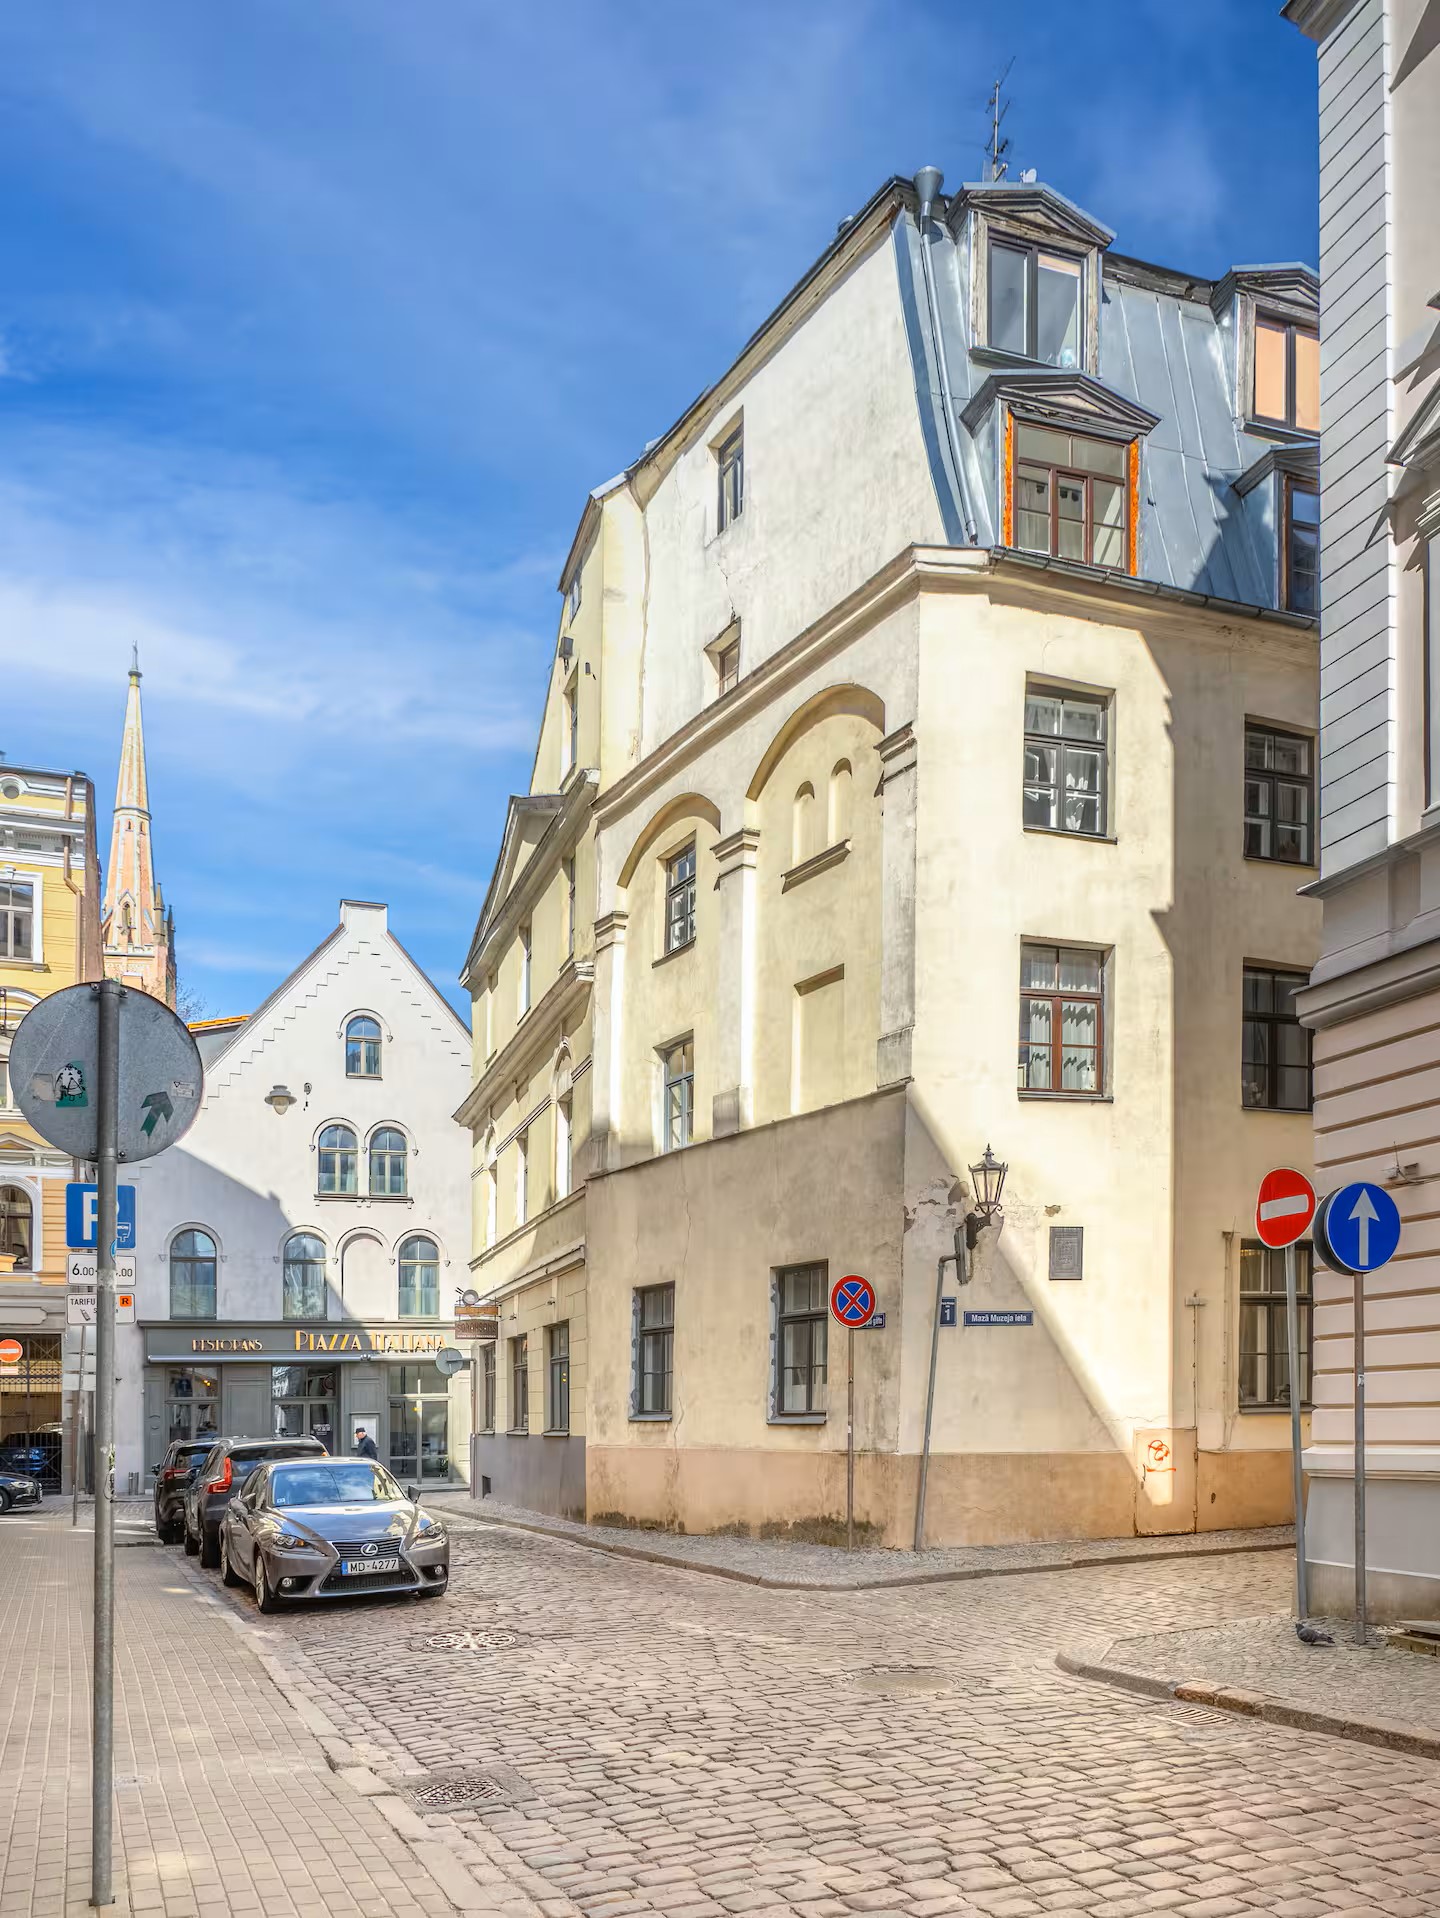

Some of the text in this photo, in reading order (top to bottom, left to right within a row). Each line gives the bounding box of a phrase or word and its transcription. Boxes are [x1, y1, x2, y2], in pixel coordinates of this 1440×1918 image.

[944, 1308, 950, 1321] 1
[971, 1314, 1027, 1323] Mazā Muzeja iela
[295, 1330, 447, 1351] PIAZZA ITALIANA
[350, 1559, 397, 1572] MD-4277
